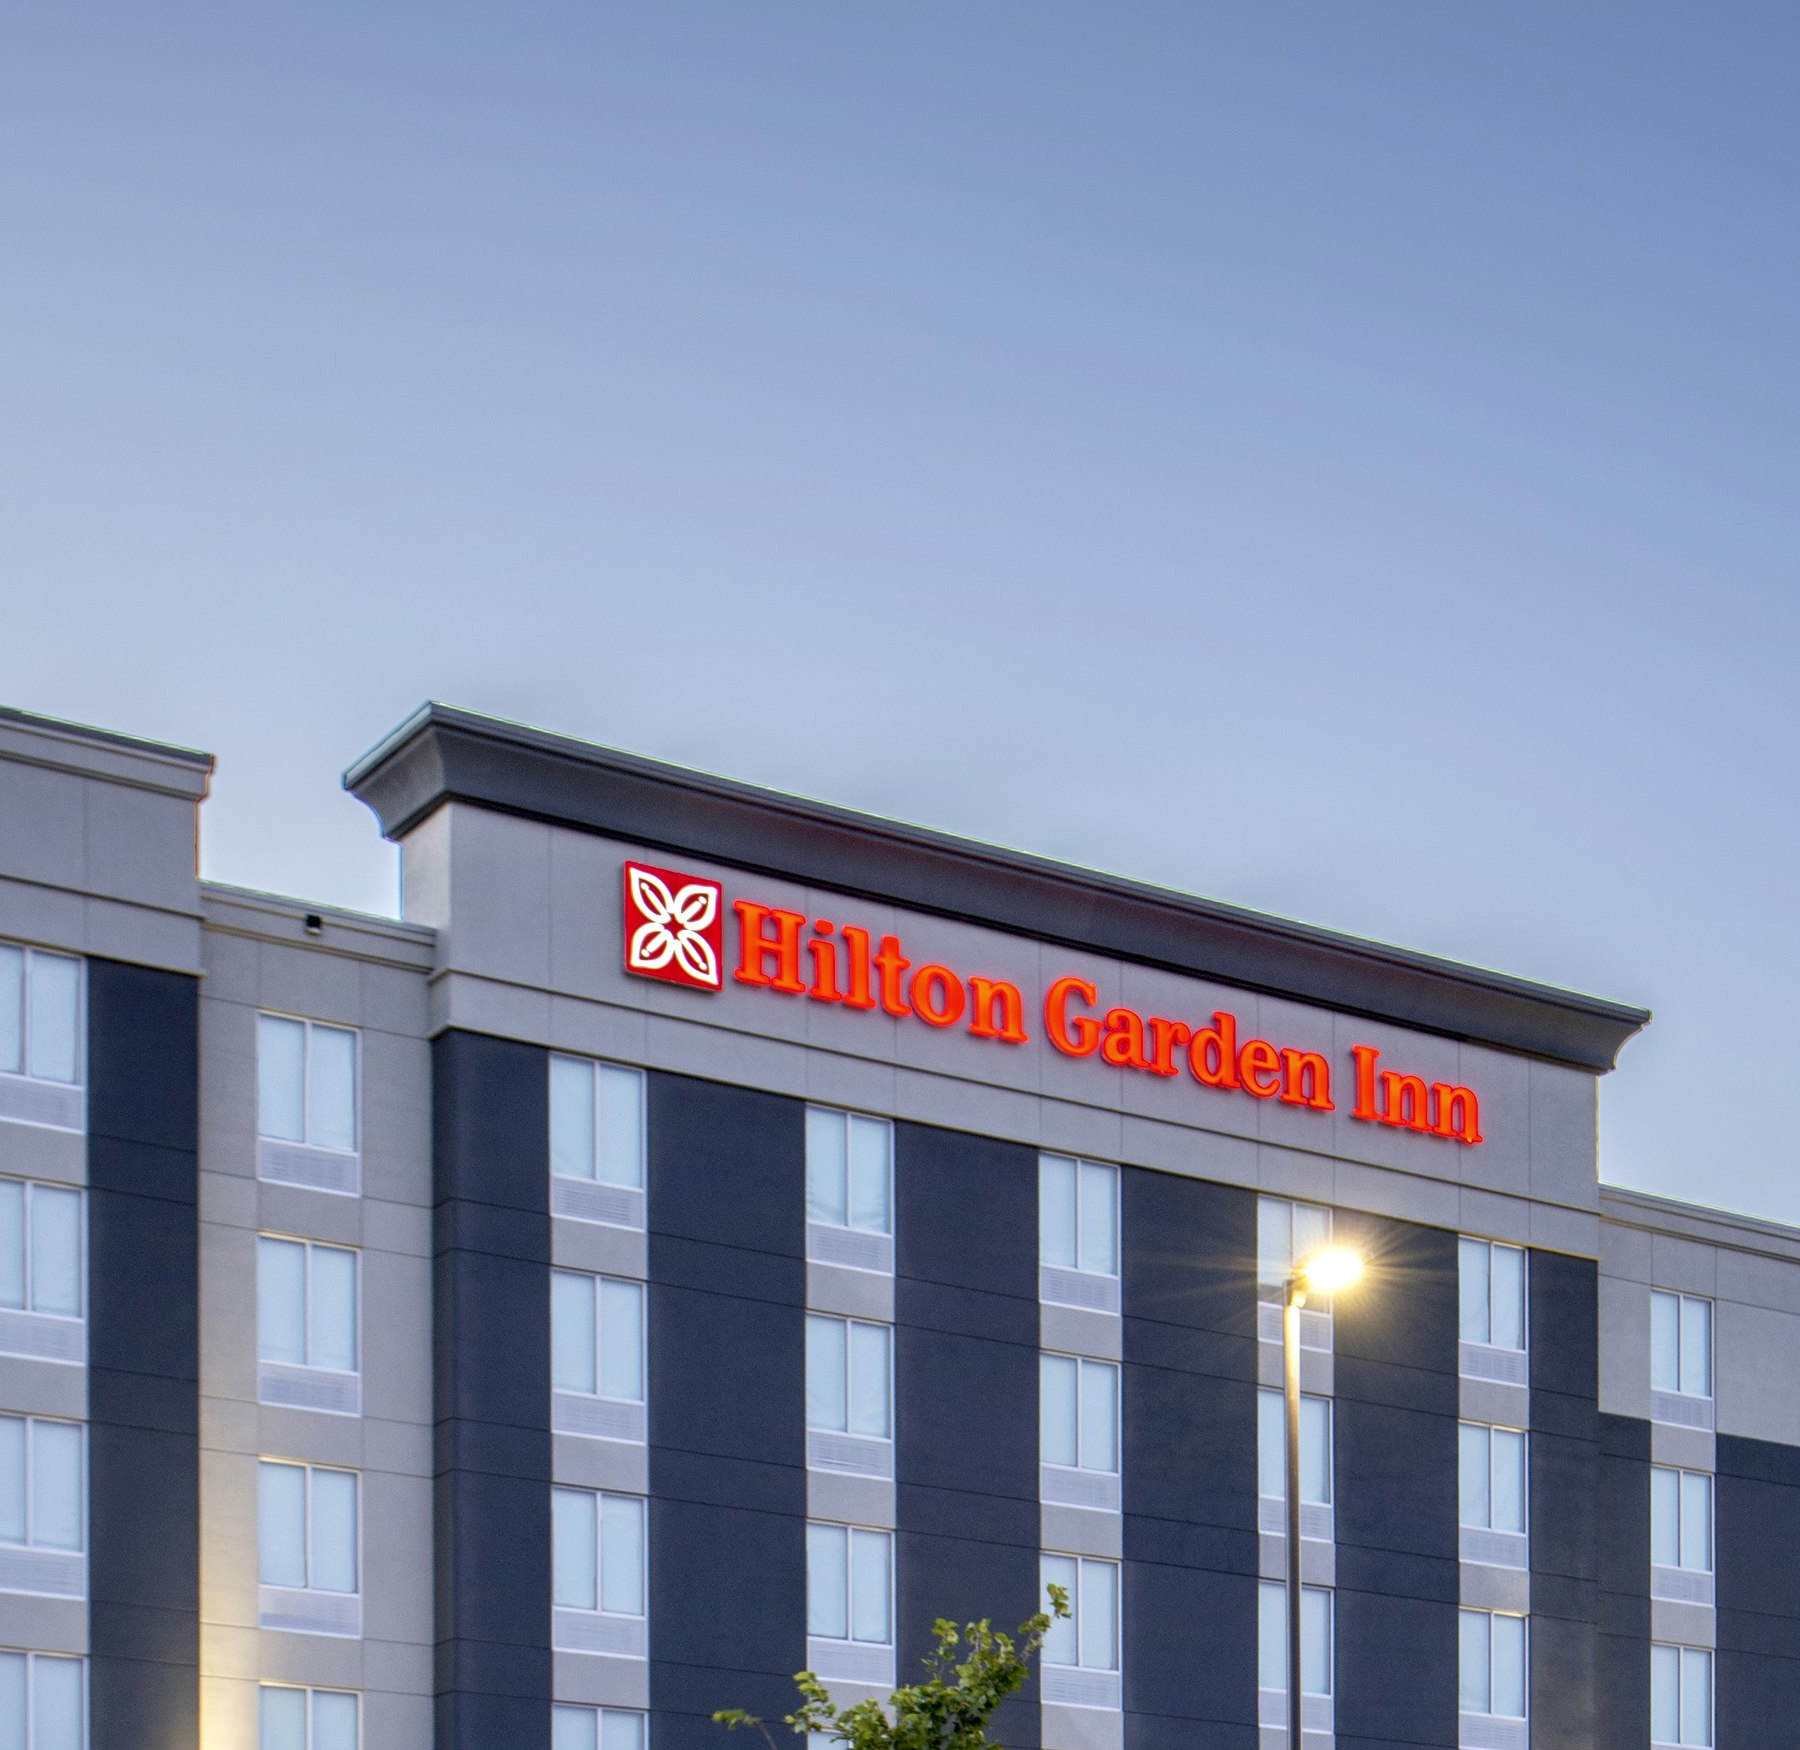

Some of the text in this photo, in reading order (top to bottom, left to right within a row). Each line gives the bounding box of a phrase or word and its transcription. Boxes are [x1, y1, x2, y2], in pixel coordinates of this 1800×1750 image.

[733, 900, 1484, 1146] Hilton Garden Inn
